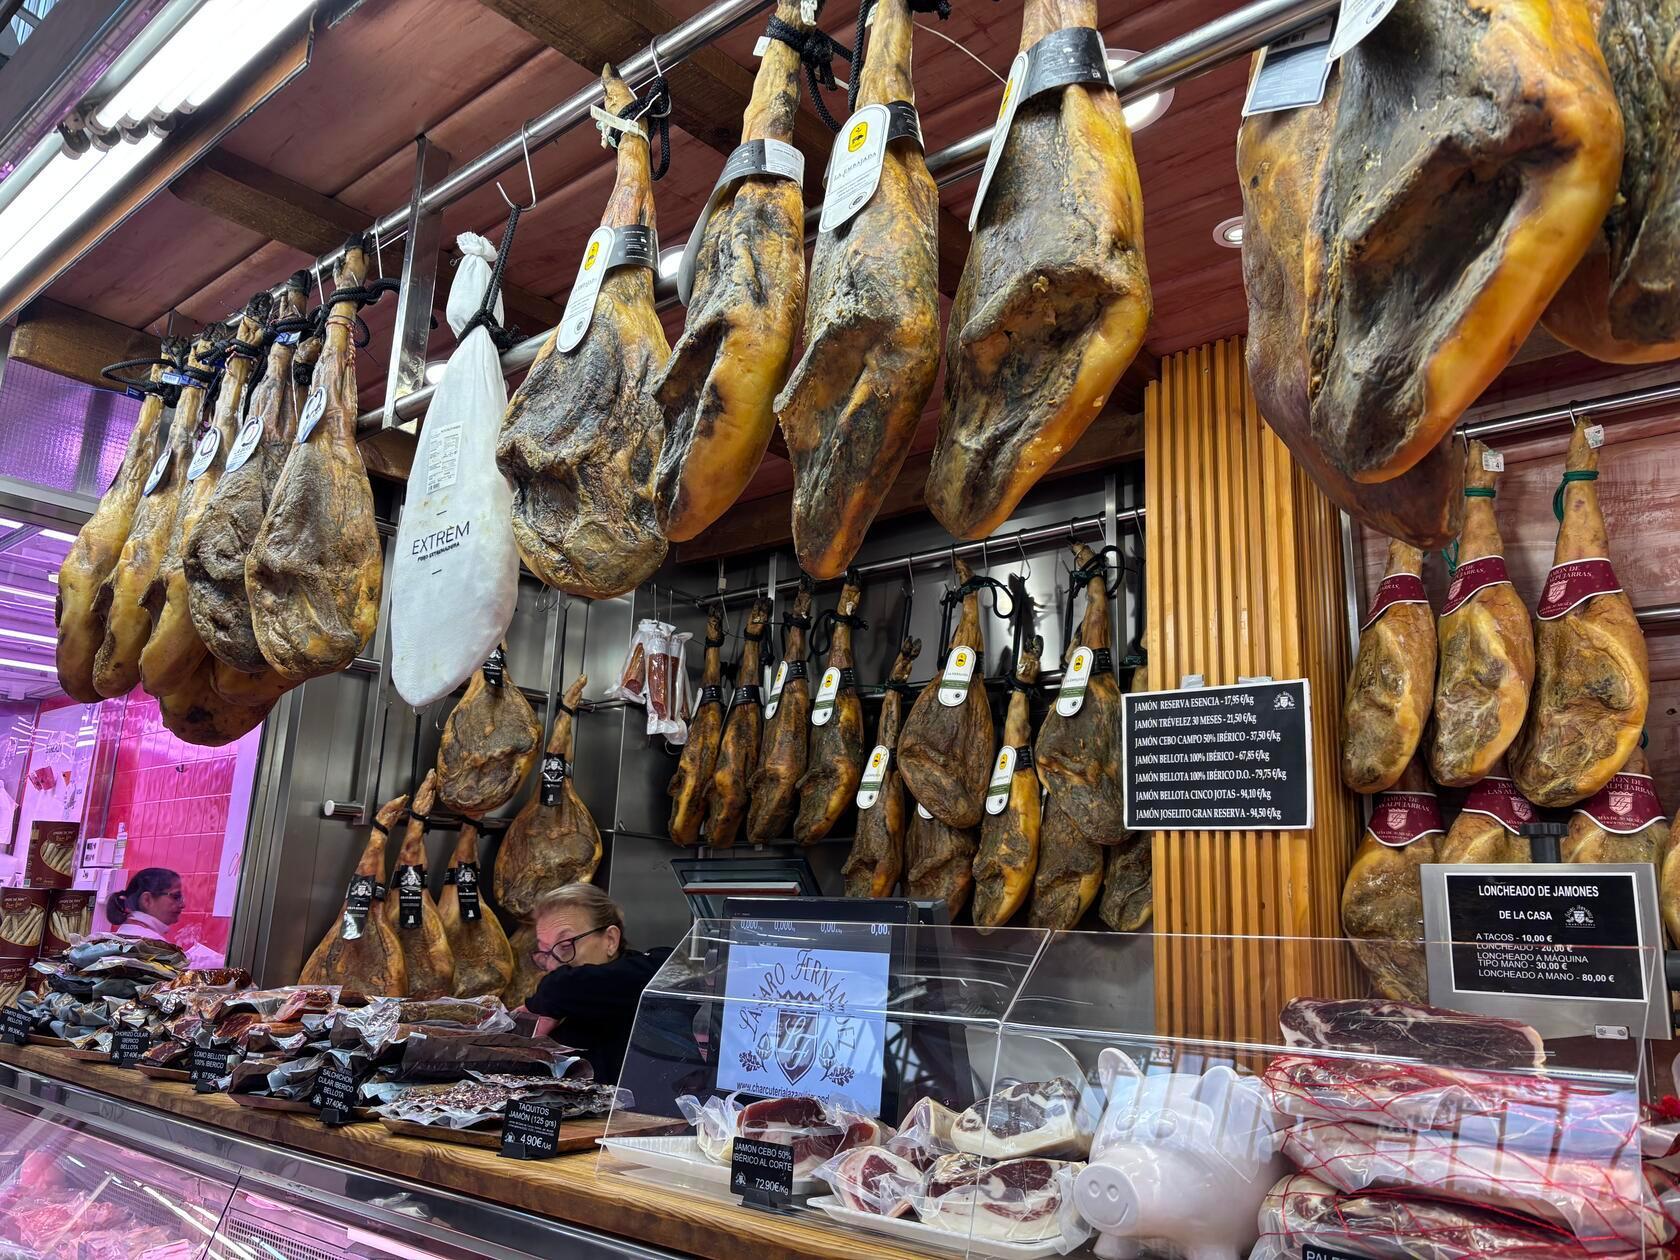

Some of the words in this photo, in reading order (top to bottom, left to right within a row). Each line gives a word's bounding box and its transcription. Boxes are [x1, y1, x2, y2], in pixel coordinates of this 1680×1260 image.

[842, 152, 877, 178] EMBAJADA
[1134, 701, 1158, 713] JAMÓN
[1160, 698, 1190, 710] RESERVA
[1191, 696, 1220, 707] ESENCIA
[1224, 695, 1239, 705] 17,95
[1240, 694, 1254, 705] €/kg
[1134, 719, 1158, 731] JAMÓN
[1159, 716, 1191, 727] TRÉVELEZ
[1192, 716, 1199, 725] 30
[1200, 714, 1222, 724] MESES
[1227, 714, 1243, 724] 21,50
[1243, 712, 1257, 724] €/kg
[1135, 736, 1158, 748] JAMÓN
[1159, 735, 1176, 745] CEBO
[1177, 734, 1202, 744] CAMPO
[1203, 734, 1216, 743] 50%
[1216, 731, 1245, 742] IBÉRICO
[1250, 731, 1266, 742] 37,50
[1267, 730, 1281, 741] €/kg
[1135, 754, 1158, 766] JAMÓN
[1159, 753, 1188, 763] BELLOTA
[1190, 752, 1205, 762] 100%
[1206, 750, 1234, 761] IBÉRICO
[1239, 751, 1254, 761] 67,85
[1255, 750, 1270, 762] €/kg
[1136, 772, 1158, 784] JAMÓN
[1160, 771, 1189, 781] BELLOTA
[1190, 771, 1205, 780] 100%
[1206, 769, 1235, 780] IBÉRICO
[1236, 770, 1250, 780] D.O.
[1255, 769, 1271, 780] 79,75
[1272, 769, 1287, 780] €/kg
[1136, 790, 1158, 802] JAMÓN
[1160, 790, 1189, 800] BELLOTA
[1191, 789, 1213, 799] CINCO
[1214, 789, 1236, 801] JOTAS
[1240, 789, 1256, 799] 94,10
[1257, 788, 1271, 800] €/kg
[1136, 808, 1159, 820] JAMÓN
[1160, 808, 1191, 820] JOSELITO
[1192, 808, 1213, 818] GRAN
[1213, 808, 1245, 818] RESERVA
[1250, 808, 1266, 818] 94,50
[1267, 807, 1281, 820] €/kg
[1386, 802, 1430, 812] ALPUJARRAS
[1478, 885, 1535, 897] LONCHEADO
[1538, 886, 1550, 897] DE
[1552, 886, 1599, 897] JAMONES
[1499, 911, 1511, 919] DE
[1513, 911, 1525, 920] LA
[1527, 911, 1552, 920] CASA
[871, 924, 888, 936] 0,00
[1484, 933, 1514, 941] TACOS
[1476, 943, 1533, 951] LONCHEADO
[1477, 952, 1534, 961] LONCHEADO
[1546, 954, 1588, 963] MÁQUINA
[1478, 959, 1498, 967] TIPO
[1501, 960, 1528, 968] MANO
[1536, 962, 1559, 970] 30,00
[1561, 962, 1568, 970] €
[1478, 970, 1535, 979] LONCHEADO
[1546, 972, 1574, 981] MANO
[1582, 974, 1607, 982] 80,00
[323, 1069, 353, 1083] SALCHICHON
[318, 1076, 334, 1087] CULAR
[335, 1082, 353, 1092] IBERICO
[323, 1087, 344, 1098] BELLOTA
[519, 1102, 549, 1115] TAQUITOS
[509, 1110, 530, 1121] JAMÓN
[531, 1116, 544, 1124] (125
[734, 1143, 757, 1153] JAMON
[758, 1147, 776, 1157] CEBO
[778, 1150, 791, 1160] 50%
[760, 1159, 767, 1167] AL
[769, 1160, 792, 1172] CORTE
